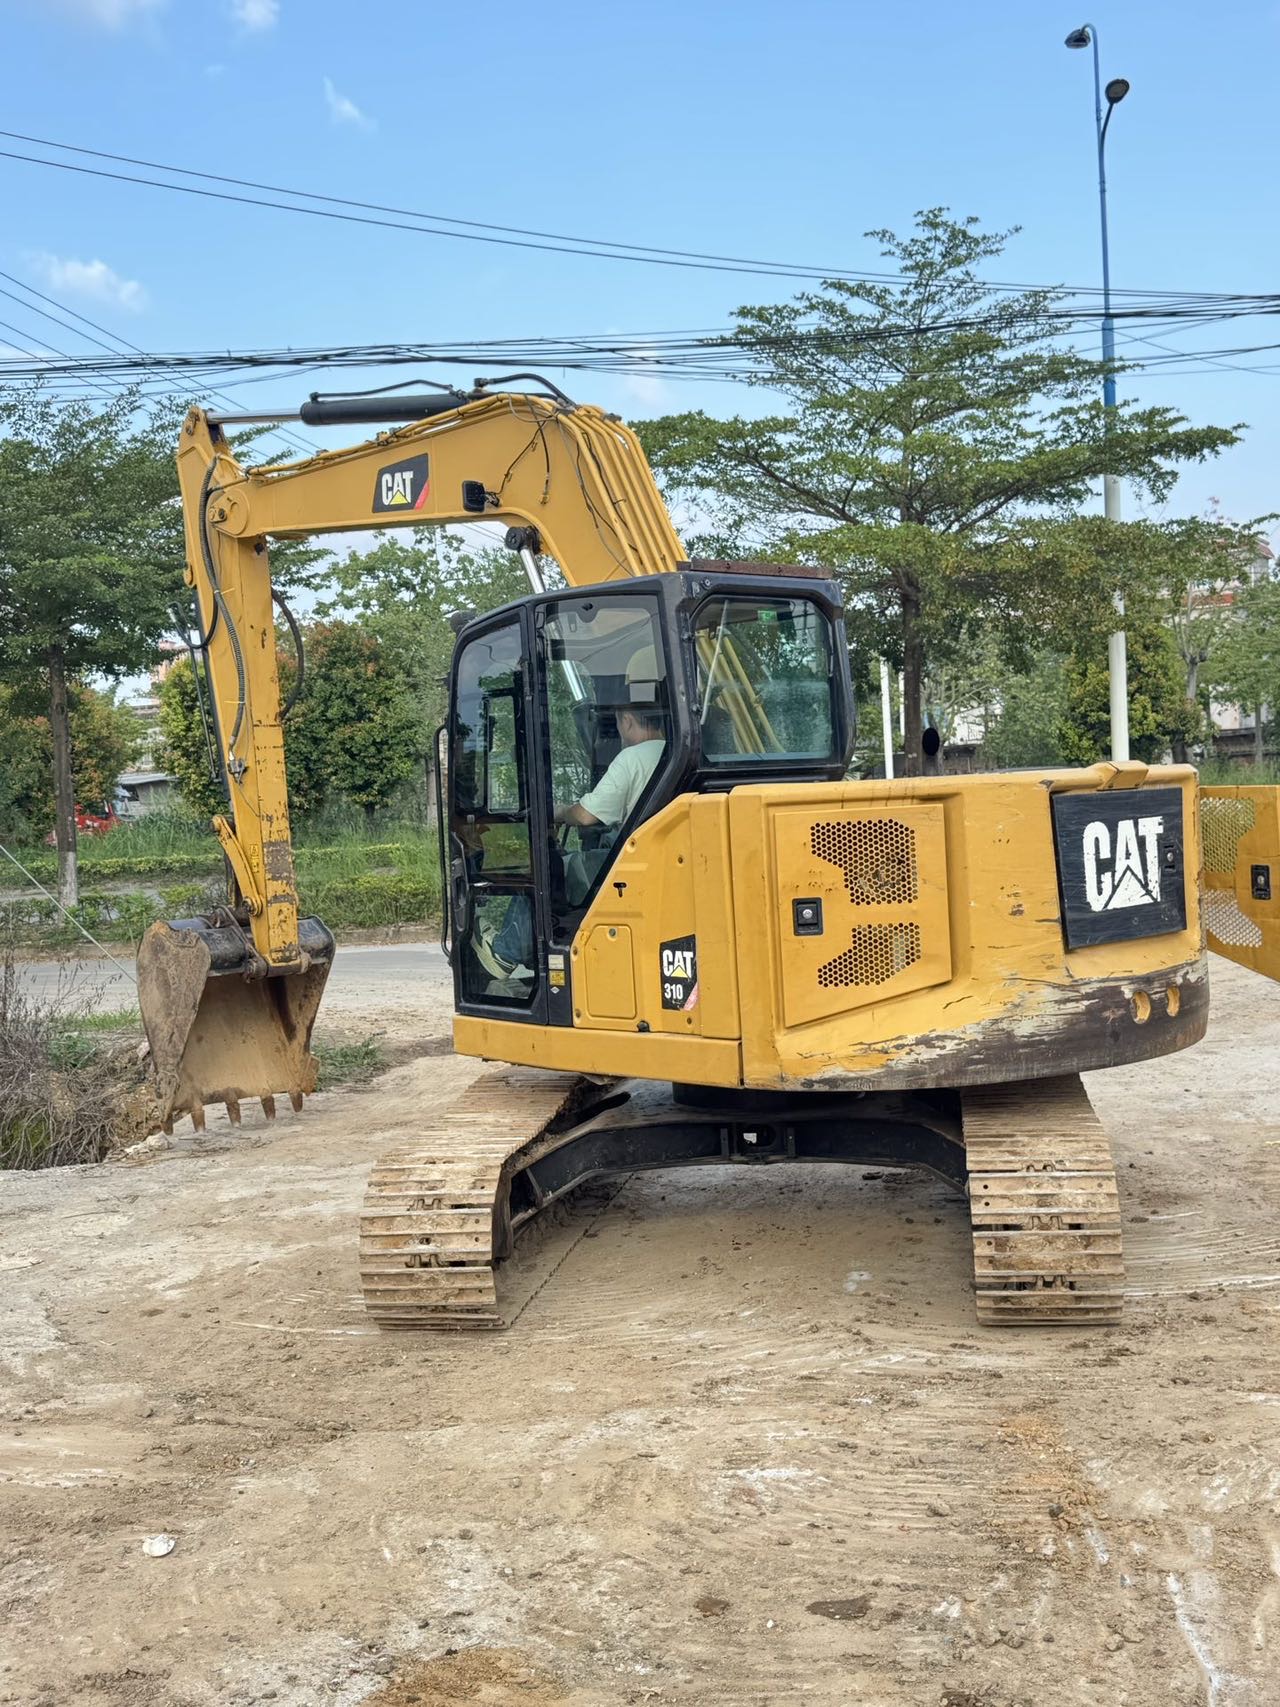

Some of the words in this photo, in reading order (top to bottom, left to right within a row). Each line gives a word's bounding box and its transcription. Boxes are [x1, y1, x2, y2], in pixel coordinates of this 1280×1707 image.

[381, 471, 414, 505] CAT
[1083, 816, 1164, 912] CAT
[662, 949, 694, 978] CAT
[664, 983, 683, 1000] 310
